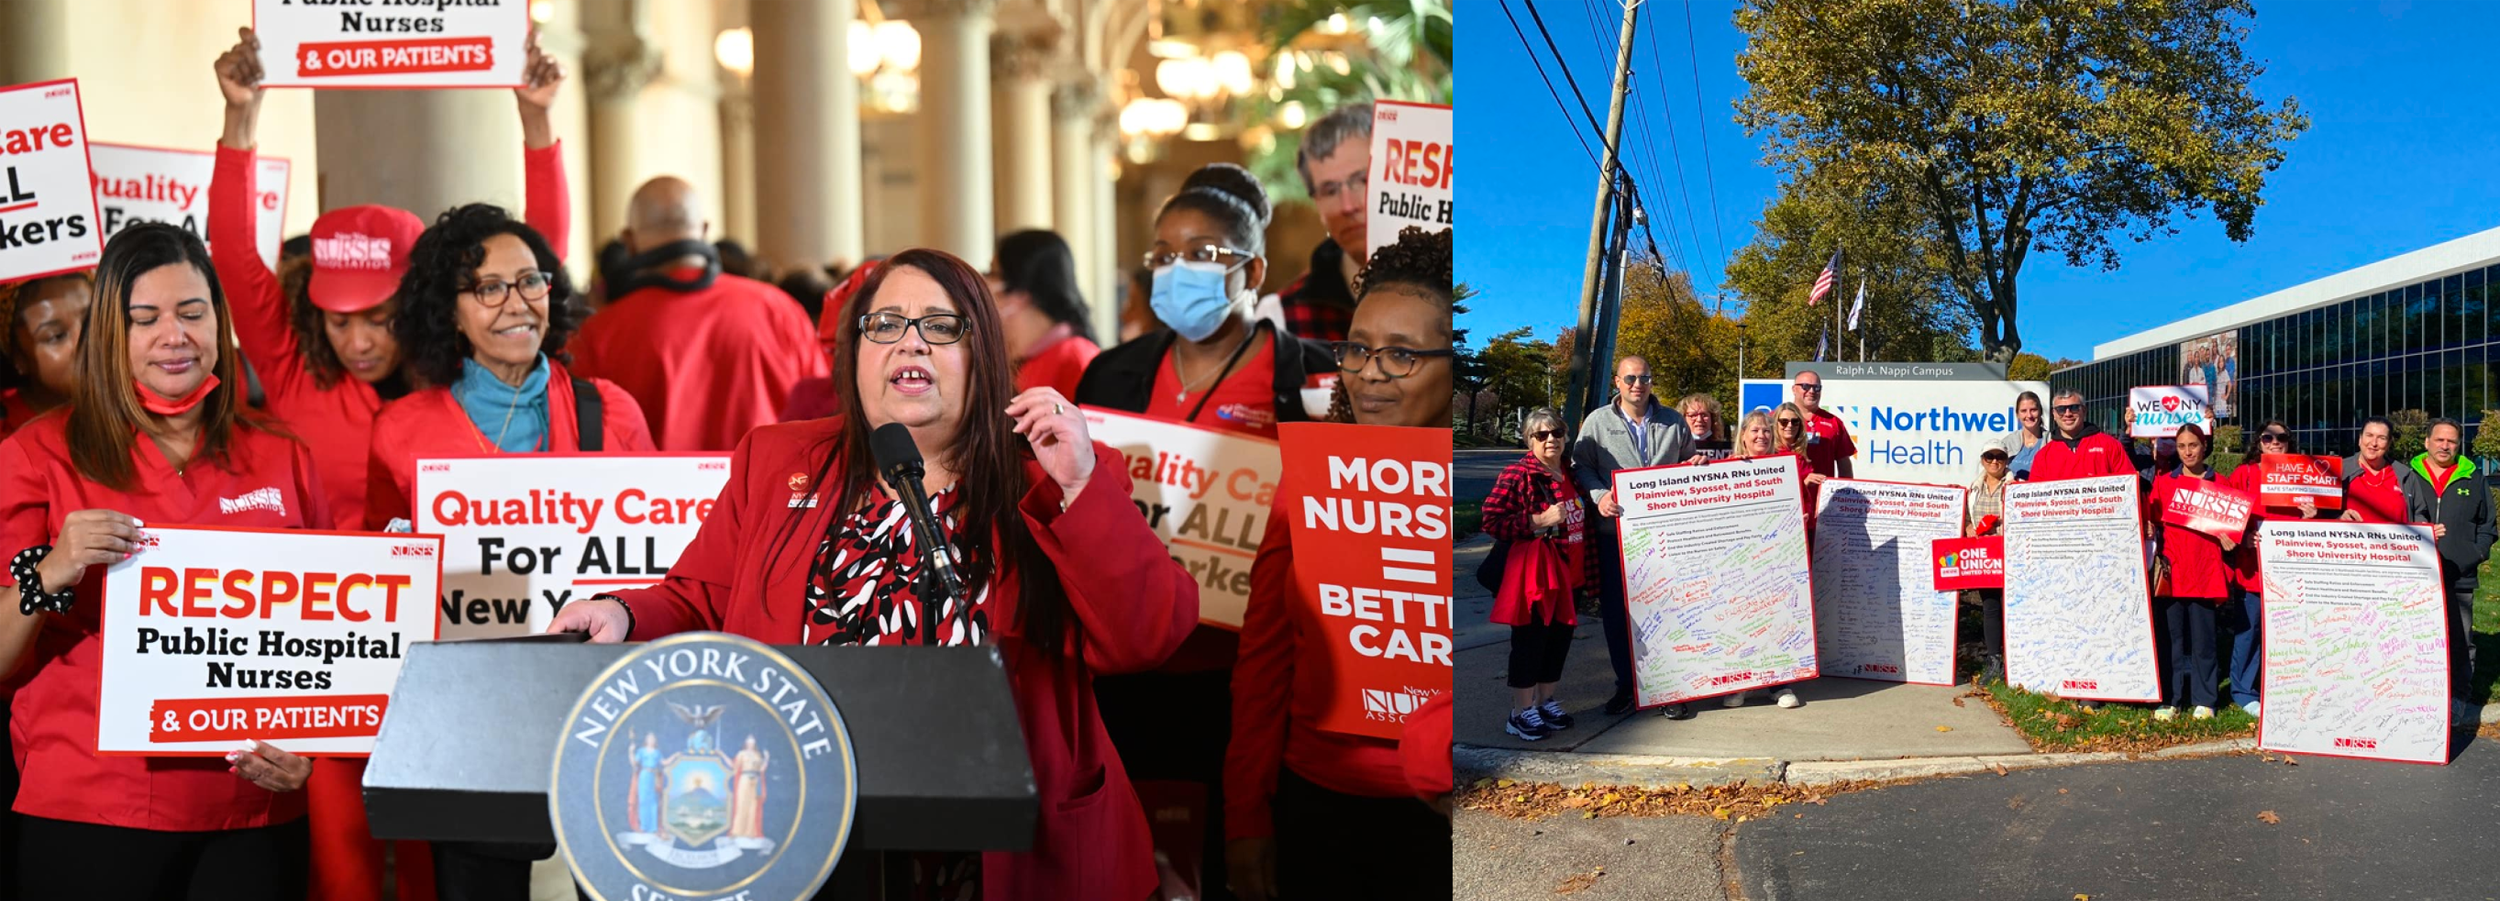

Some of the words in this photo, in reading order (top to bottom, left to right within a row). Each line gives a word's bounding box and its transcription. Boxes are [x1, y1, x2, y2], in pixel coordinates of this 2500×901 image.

[341, 11, 444, 32] Nurses
[305, 50, 322, 70] &
[327, 48, 377, 69] OUR
[381, 44, 486, 67] PATIENTS
[0, 123, 73, 155] are
[1383, 137, 1453, 189] RESP
[1379, 191, 1431, 221] Public
[0, 214, 86, 250] kers
[314, 237, 391, 260] NURSES
[1836, 365, 1865, 376] Ralph
[1866, 366, 1877, 375] A.
[1880, 366, 1910, 376] Nappi
[1912, 366, 1953, 376] Campus
[2137, 400, 2160, 412] WE
[2181, 399, 2202, 410] NY
[2136, 411, 2204, 426] nurses
[1870, 439, 1963, 465] Health
[1125, 451, 1219, 499] ality
[1226, 467, 1277, 507] Ca
[1328, 455, 1453, 497] MOR
[1629, 480, 1656, 491] Long
[1659, 476, 1690, 486] Island
[1692, 472, 1728, 483] NYSNA
[1731, 470, 1751, 479] RNs
[1753, 465, 1785, 476] United
[2267, 473, 2301, 483] STAFF
[2302, 475, 2338, 485] SMART
[2276, 463, 2304, 472] HAVE
[2306, 464, 2313, 473] A
[1635, 489, 1687, 501] Plainview,
[1690, 484, 1731, 495] Syosset,
[1734, 479, 1752, 489] and
[1754, 477, 1783, 488] South
[1647, 501, 1677, 511] Shore
[1679, 494, 1731, 507] University
[1734, 488, 1774, 501] Hospital
[1851, 488, 1876, 496] Island
[1878, 490, 1907, 498] NYSNA
[1926, 493, 1954, 501] United
[2031, 489, 2052, 498] Island
[2054, 488, 2080, 496] NYSNA
[2099, 484, 2126, 493] United
[2200, 487, 2217, 496] New
[2218, 492, 2233, 501] York
[2233, 496, 2251, 505] State
[432, 488, 603, 534] Quality
[614, 488, 716, 525] Care
[1866, 507, 1905, 517] University
[1907, 510, 1941, 518] Hospital
[1874, 499, 1907, 507] Syosset,
[2014, 500, 2049, 508] Plainview,
[2050, 498, 2080, 507] Syosset,
[2082, 496, 2096, 504] and
[2098, 495, 2122, 503] South
[2021, 510, 2041, 518] Shore
[2042, 508, 2079, 517] University
[2081, 506, 2115, 515] Hospital
[2172, 488, 2249, 519] NURSES
[1303, 495, 1453, 540] NURS
[2169, 502, 2244, 526] ASSOCIATION
[1178, 502, 1260, 551] ALL
[2270, 529, 2295, 538] Long
[2297, 529, 2327, 538] Island
[2329, 531, 2365, 539] NYSNA
[2367, 532, 2386, 540] RNs
[2388, 533, 2421, 541] United
[391, 545, 435, 556] NURSES
[478, 537, 561, 576] For
[576, 536, 670, 574] ALL
[1960, 548, 1987, 559] ONE
[2275, 539, 2325, 548] Plainview,
[2326, 541, 2367, 550] Syosset,
[2369, 542, 2388, 550] and
[2390, 543, 2419, 551] South
[2286, 550, 2314, 558] Shore
[2317, 550, 2367, 561] University
[2370, 553, 2411, 562] Hospital
[1960, 558, 2002, 570] UNION
[139, 567, 411, 622] RESPECT
[1318, 583, 1453, 629] BETT
[441, 590, 531, 625] New
[136, 627, 248, 656] Public
[257, 630, 400, 664] Hospital
[1349, 624, 1453, 667] CAR
[206, 662, 332, 689] Nurses
[1711, 672, 1752, 686] NURSES
[1865, 664, 1898, 673] NURSES
[1403, 685, 1430, 697] New
[2063, 680, 2098, 689] NURSES
[575, 670, 641, 749] NEW
[645, 647, 750, 684] YORK
[752, 667, 831, 760] STATE
[161, 709, 180, 732] &
[189, 708, 248, 732] OUR
[255, 704, 379, 729] PATIENTS
[2334, 737, 2377, 749] NURSES
